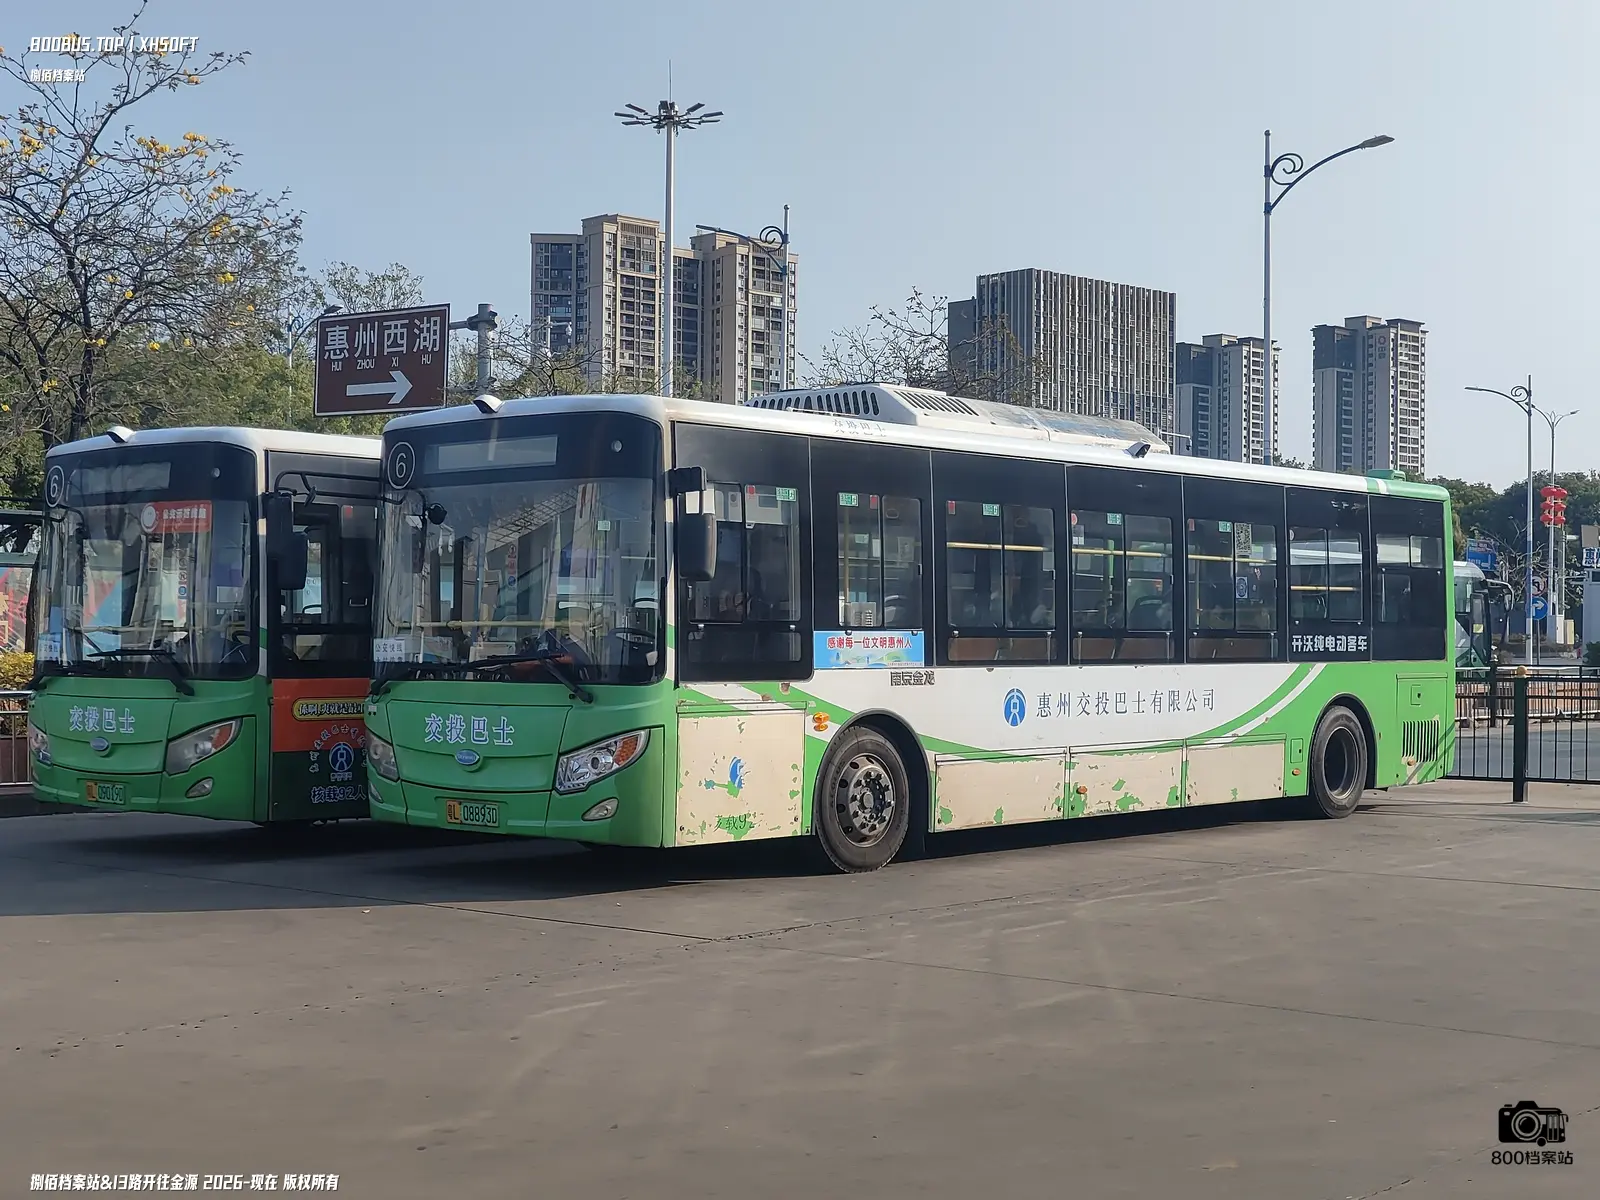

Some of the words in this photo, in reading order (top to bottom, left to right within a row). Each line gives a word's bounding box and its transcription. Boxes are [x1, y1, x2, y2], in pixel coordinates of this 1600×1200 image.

[324, 316, 441, 360] 惠州西湖
[331, 361, 343, 372] HUI
[356, 358, 376, 370] ZHOU
[391, 356, 400, 368] XI
[421, 354, 433, 365] HU
[396, 452, 407, 479] 6
[50, 474, 60, 498] 6
[827, 636, 912, 649] 感谢每一位文明惠州人
[1291, 634, 1368, 652] 开沃纯电动客车
[890, 670, 935, 687] 南京金龙
[1036, 688, 1215, 718] 惠州交投巴士有限公司
[69, 705, 136, 734] 交投巴士
[424, 713, 515, 746] 交投巴士
[311, 785, 367, 804] 核载92人
